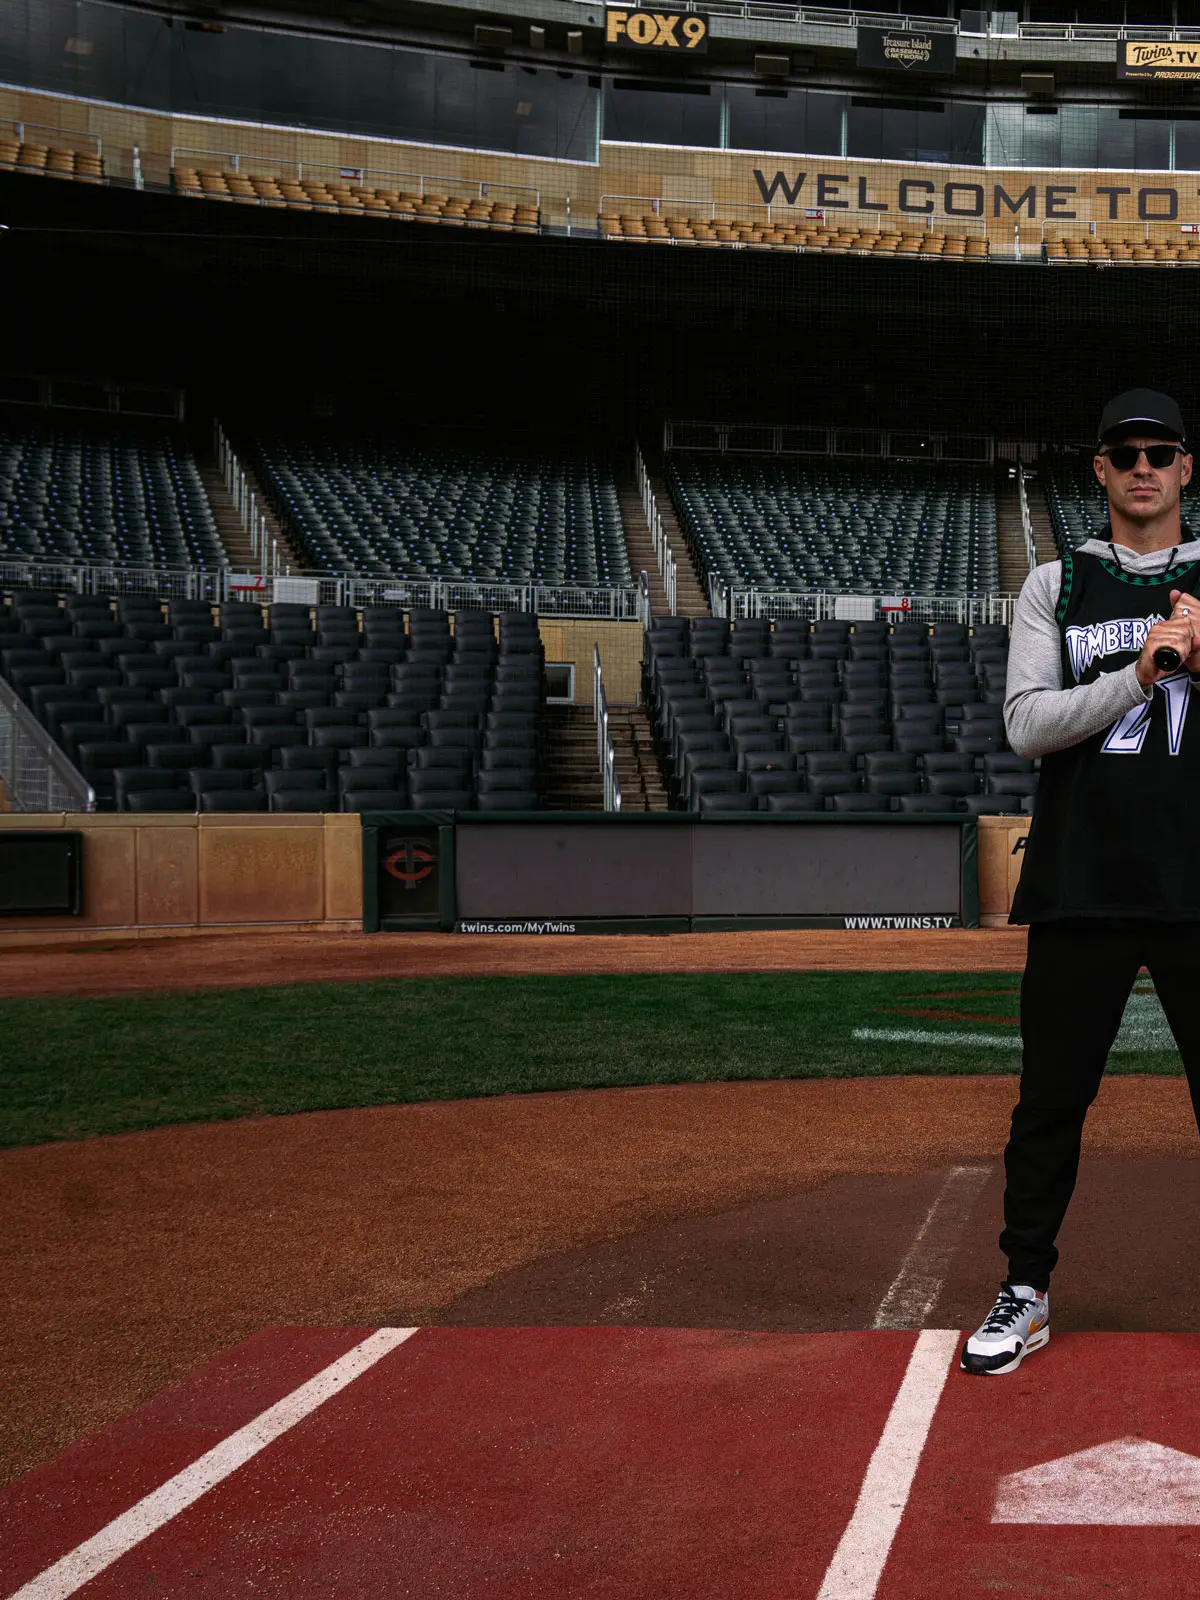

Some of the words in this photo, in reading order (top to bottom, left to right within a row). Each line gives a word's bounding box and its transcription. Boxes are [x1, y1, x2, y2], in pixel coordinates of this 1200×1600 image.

[607, 11, 680, 47] FOX
[682, 17, 706, 48] 9
[882, 36, 910, 47] Treasure
[911, 38, 931, 49] Island
[1133, 45, 1172, 63] Twins
[1176, 51, 1198, 63] TV
[752, 169, 1077, 219] WELCOME
[1096, 186, 1178, 220] TO
[253, 576, 264, 588] 7
[901, 597, 909, 610] 8
[460, 922, 576, 934] twins.com/MyTwins
[844, 917, 953, 929] WWW.TWINS.TV
